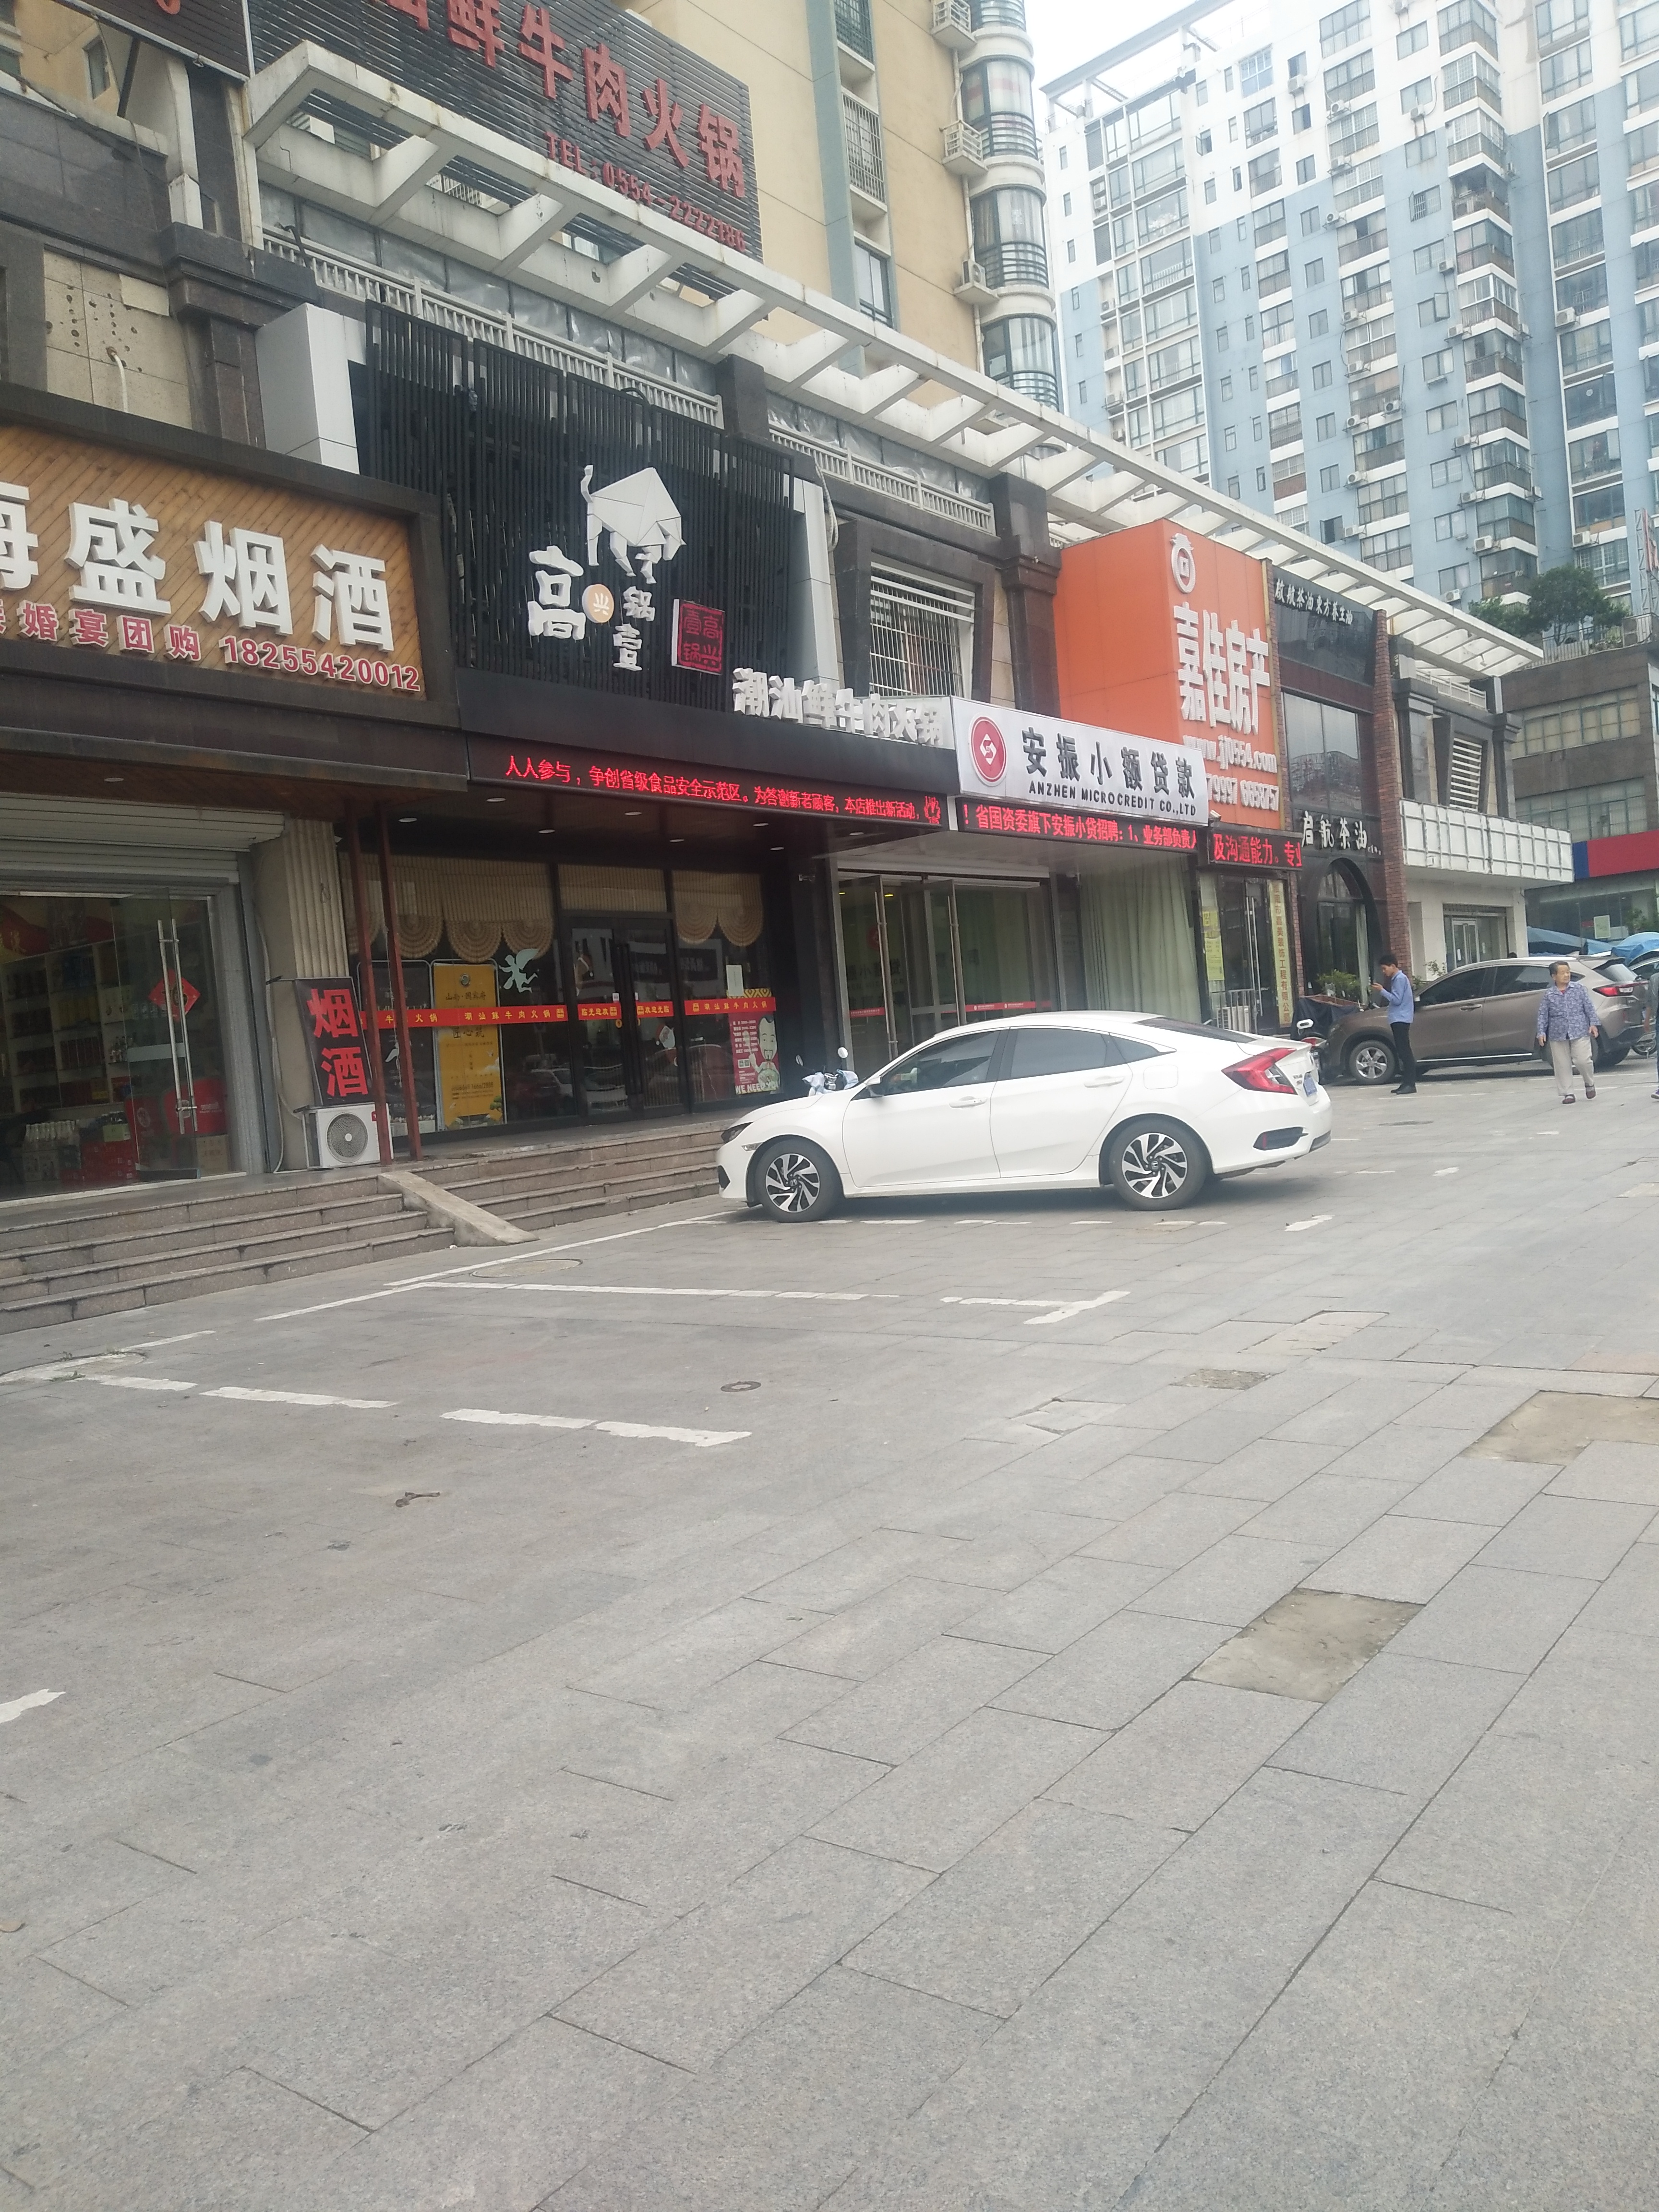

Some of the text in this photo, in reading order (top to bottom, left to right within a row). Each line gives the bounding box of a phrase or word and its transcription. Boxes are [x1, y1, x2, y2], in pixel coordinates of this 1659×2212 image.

[387, 0, 745, 198] 鲜牛肉火锅
[0, 599, 202, 661] 婚宴团购
[220, 635, 421, 693] 18255420012
[1173, 601, 1271, 735] 嘉佳房产
[732, 667, 945, 746] 潮汕鲜牛肉火锅
[1022, 726, 1195, 799] 安振小额贷款
[1029, 780, 1076, 800] ANZHEN
[1081, 788, 1155, 810] MICROCREDIT
[464, 1010, 551, 1021] 潮汕鲜牛肉火锅
[645, 1005, 670, 1013] 欢迎光临
[704, 1001, 767, 1010] 潮汕鲜牛肉火锅
[307, 989, 368, 1097] 烟酒
